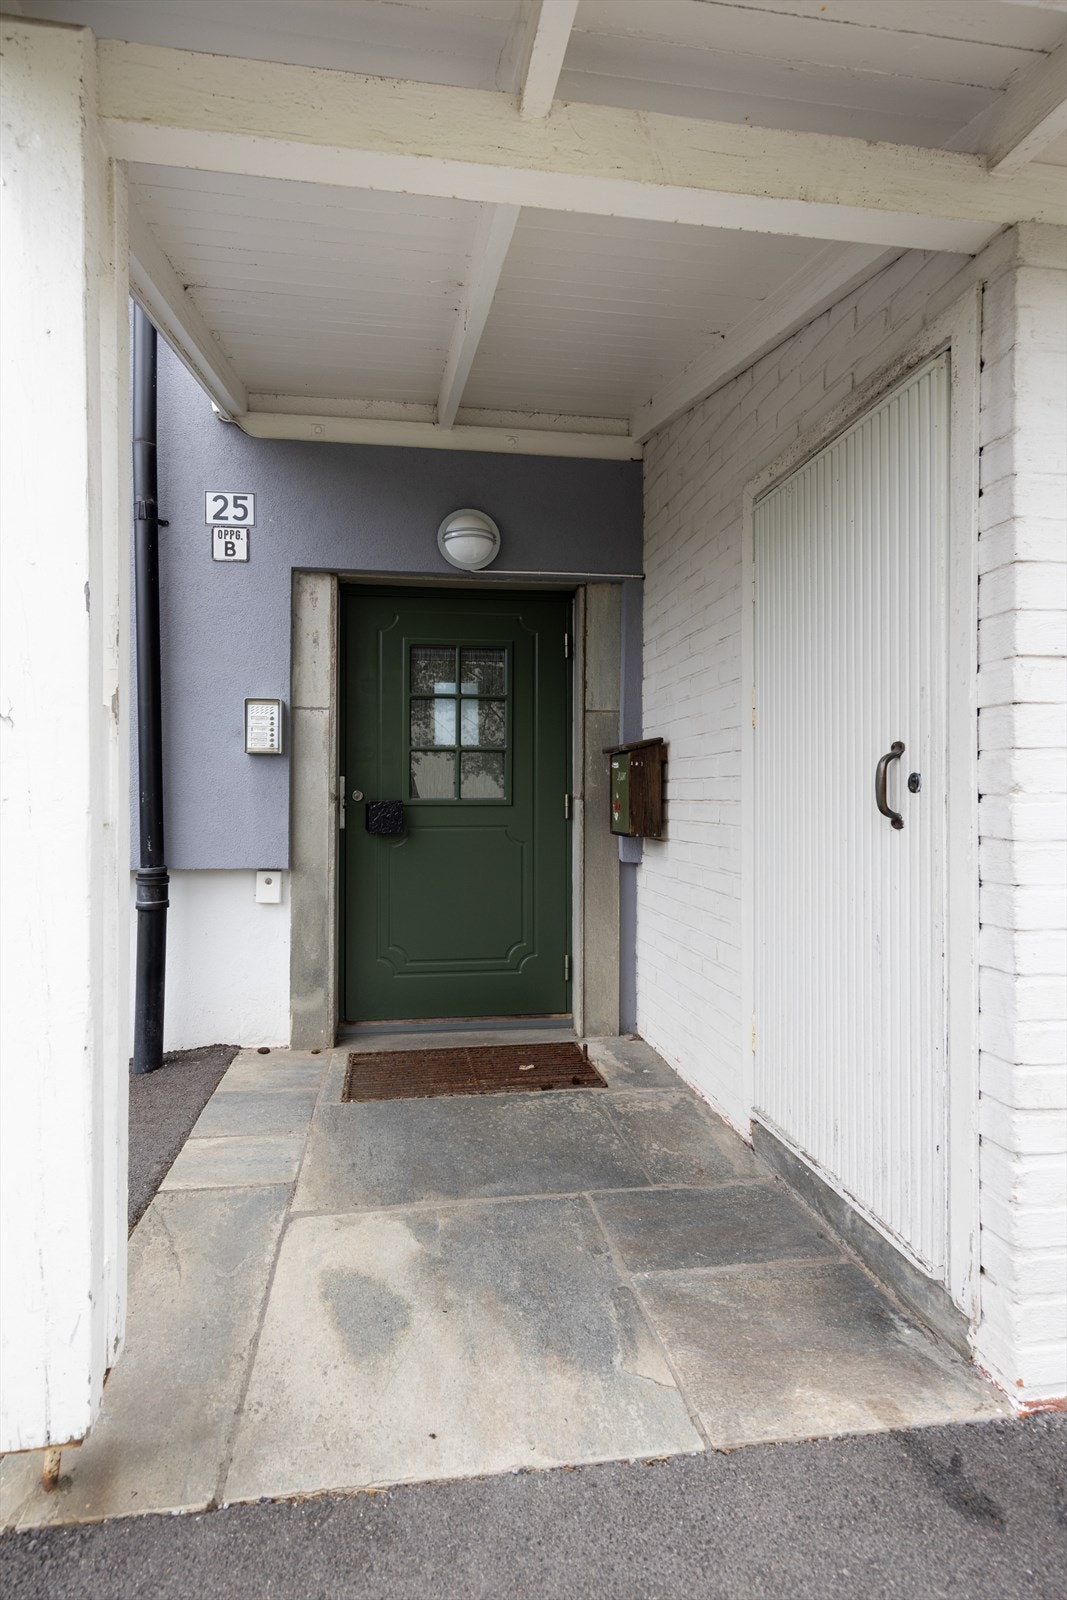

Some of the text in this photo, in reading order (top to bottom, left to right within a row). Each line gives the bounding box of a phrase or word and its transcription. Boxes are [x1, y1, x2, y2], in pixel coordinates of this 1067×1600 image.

[212, 494, 249, 521] 25
[217, 529, 243, 541] OPPG.
[224, 540, 236, 557] B
